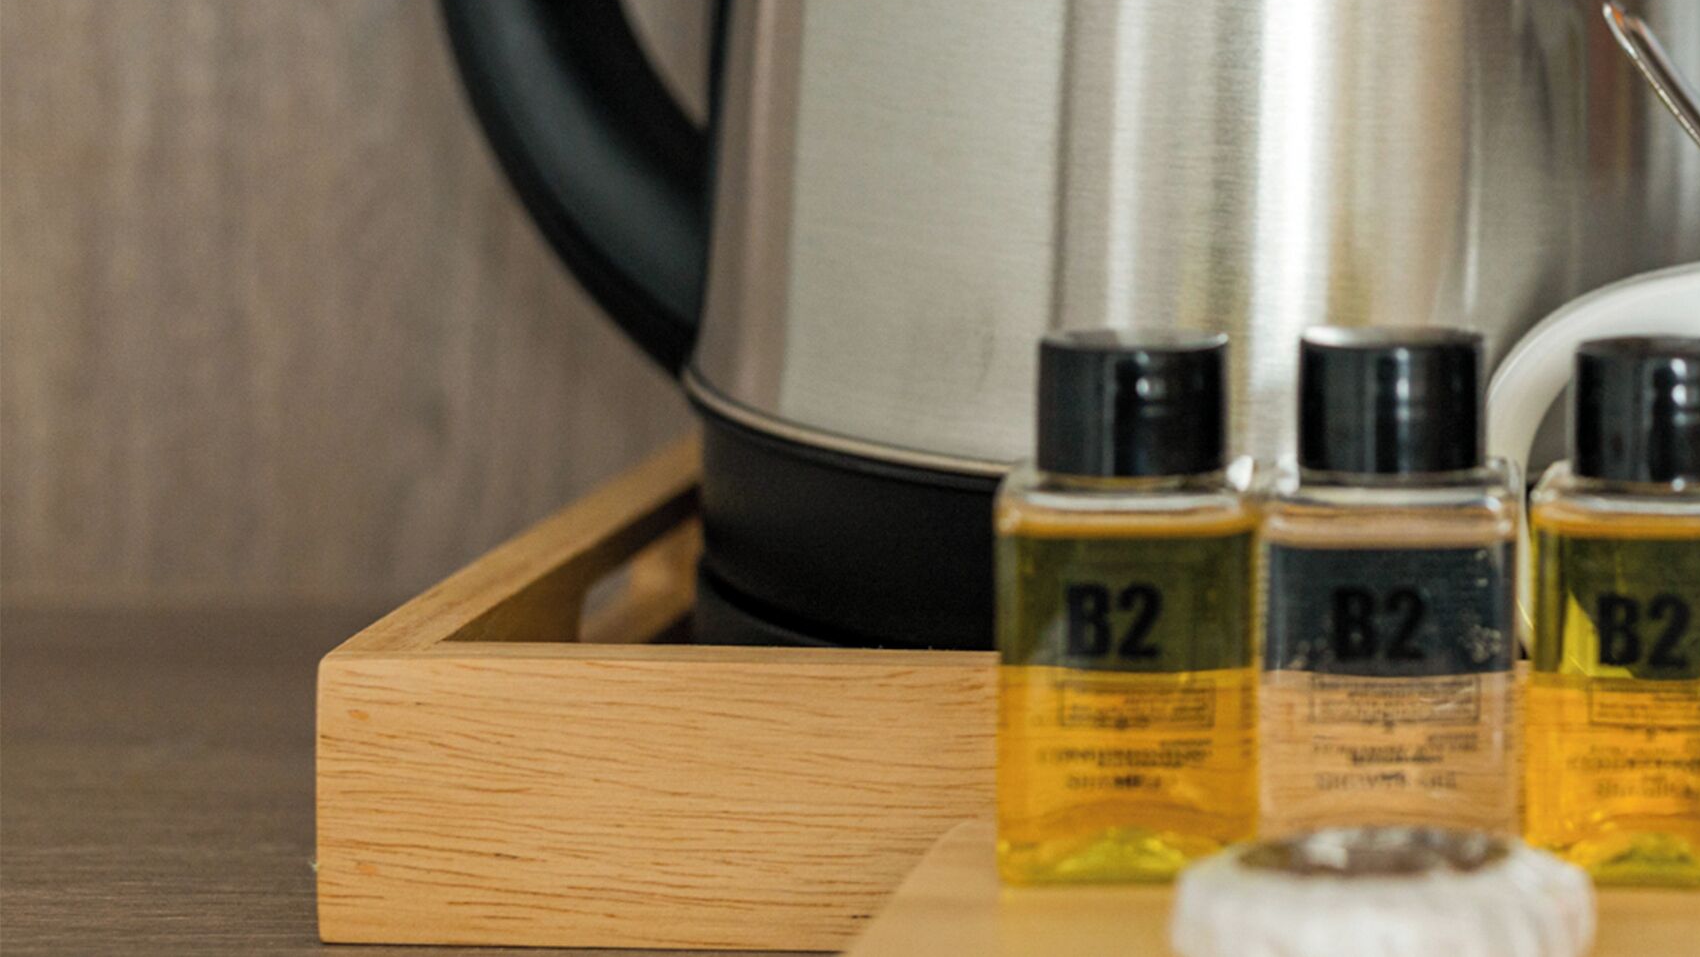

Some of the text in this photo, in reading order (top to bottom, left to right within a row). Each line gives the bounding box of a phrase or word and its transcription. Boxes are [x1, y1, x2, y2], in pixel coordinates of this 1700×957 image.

[1065, 580, 1164, 660] B2
[1332, 586, 1427, 661] B2
[1598, 593, 1691, 669] B2
